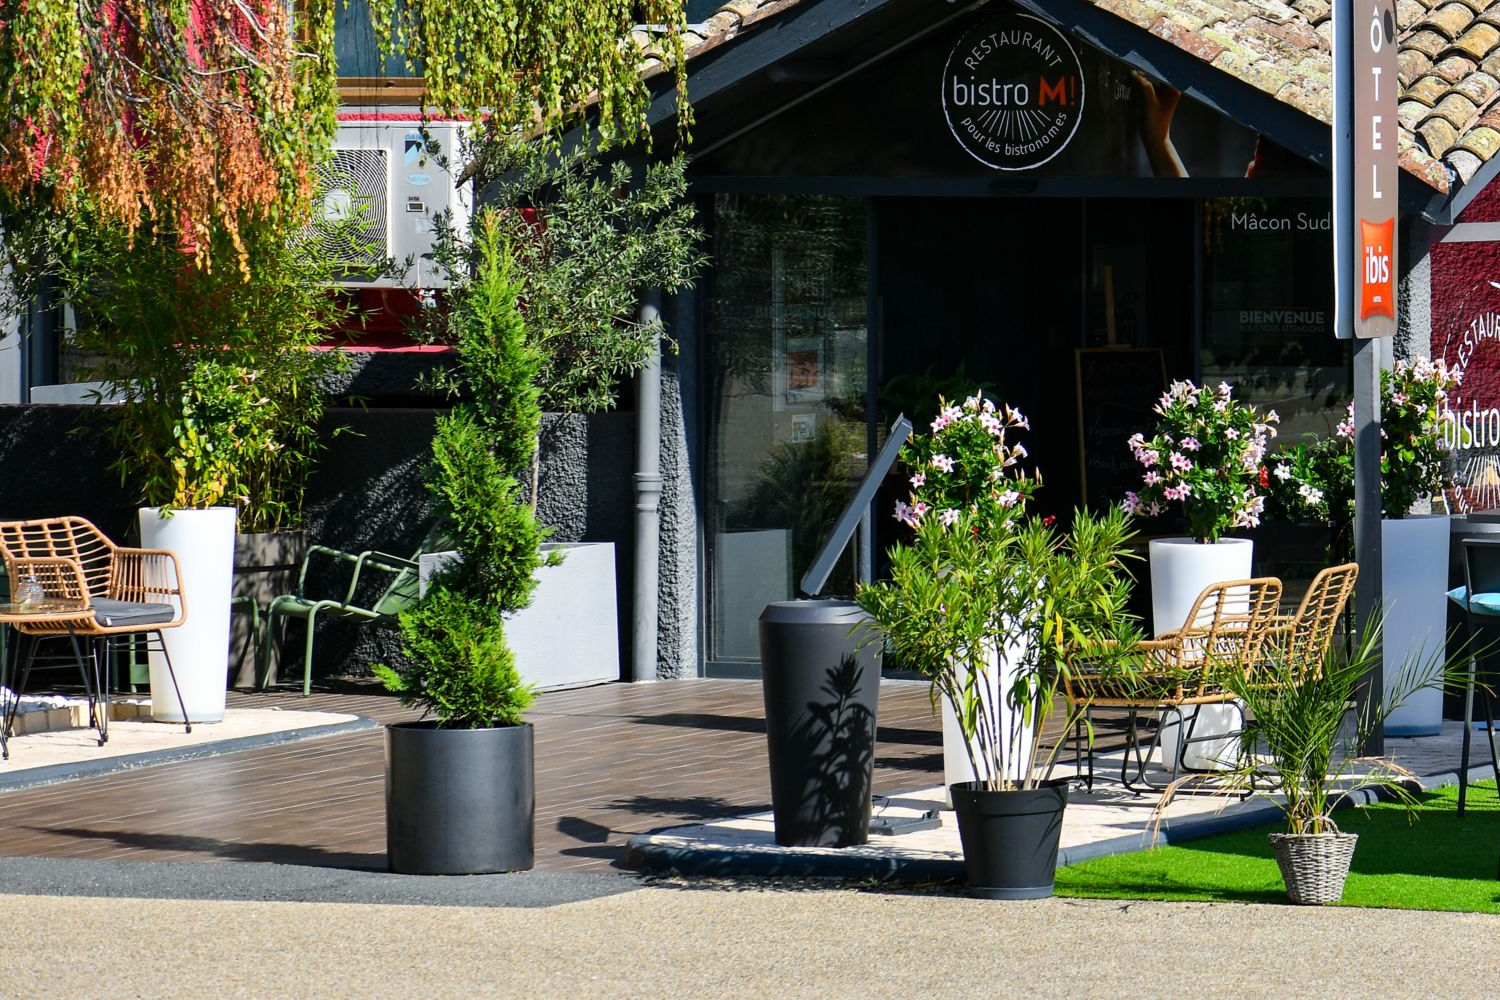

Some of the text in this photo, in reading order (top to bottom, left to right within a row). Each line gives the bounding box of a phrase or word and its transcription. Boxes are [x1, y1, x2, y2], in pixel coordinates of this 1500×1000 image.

[964, 30, 1063, 71] RESTAURANT
[953, 75, 1075, 106] bistro M!
[961, 112, 1067, 156] pour les bistronomes
[1231, 211, 1331, 230] Mâcon Sud
[1365, 245, 1389, 284] ibis
[1239, 311, 1325, 325] BIENVENUE
